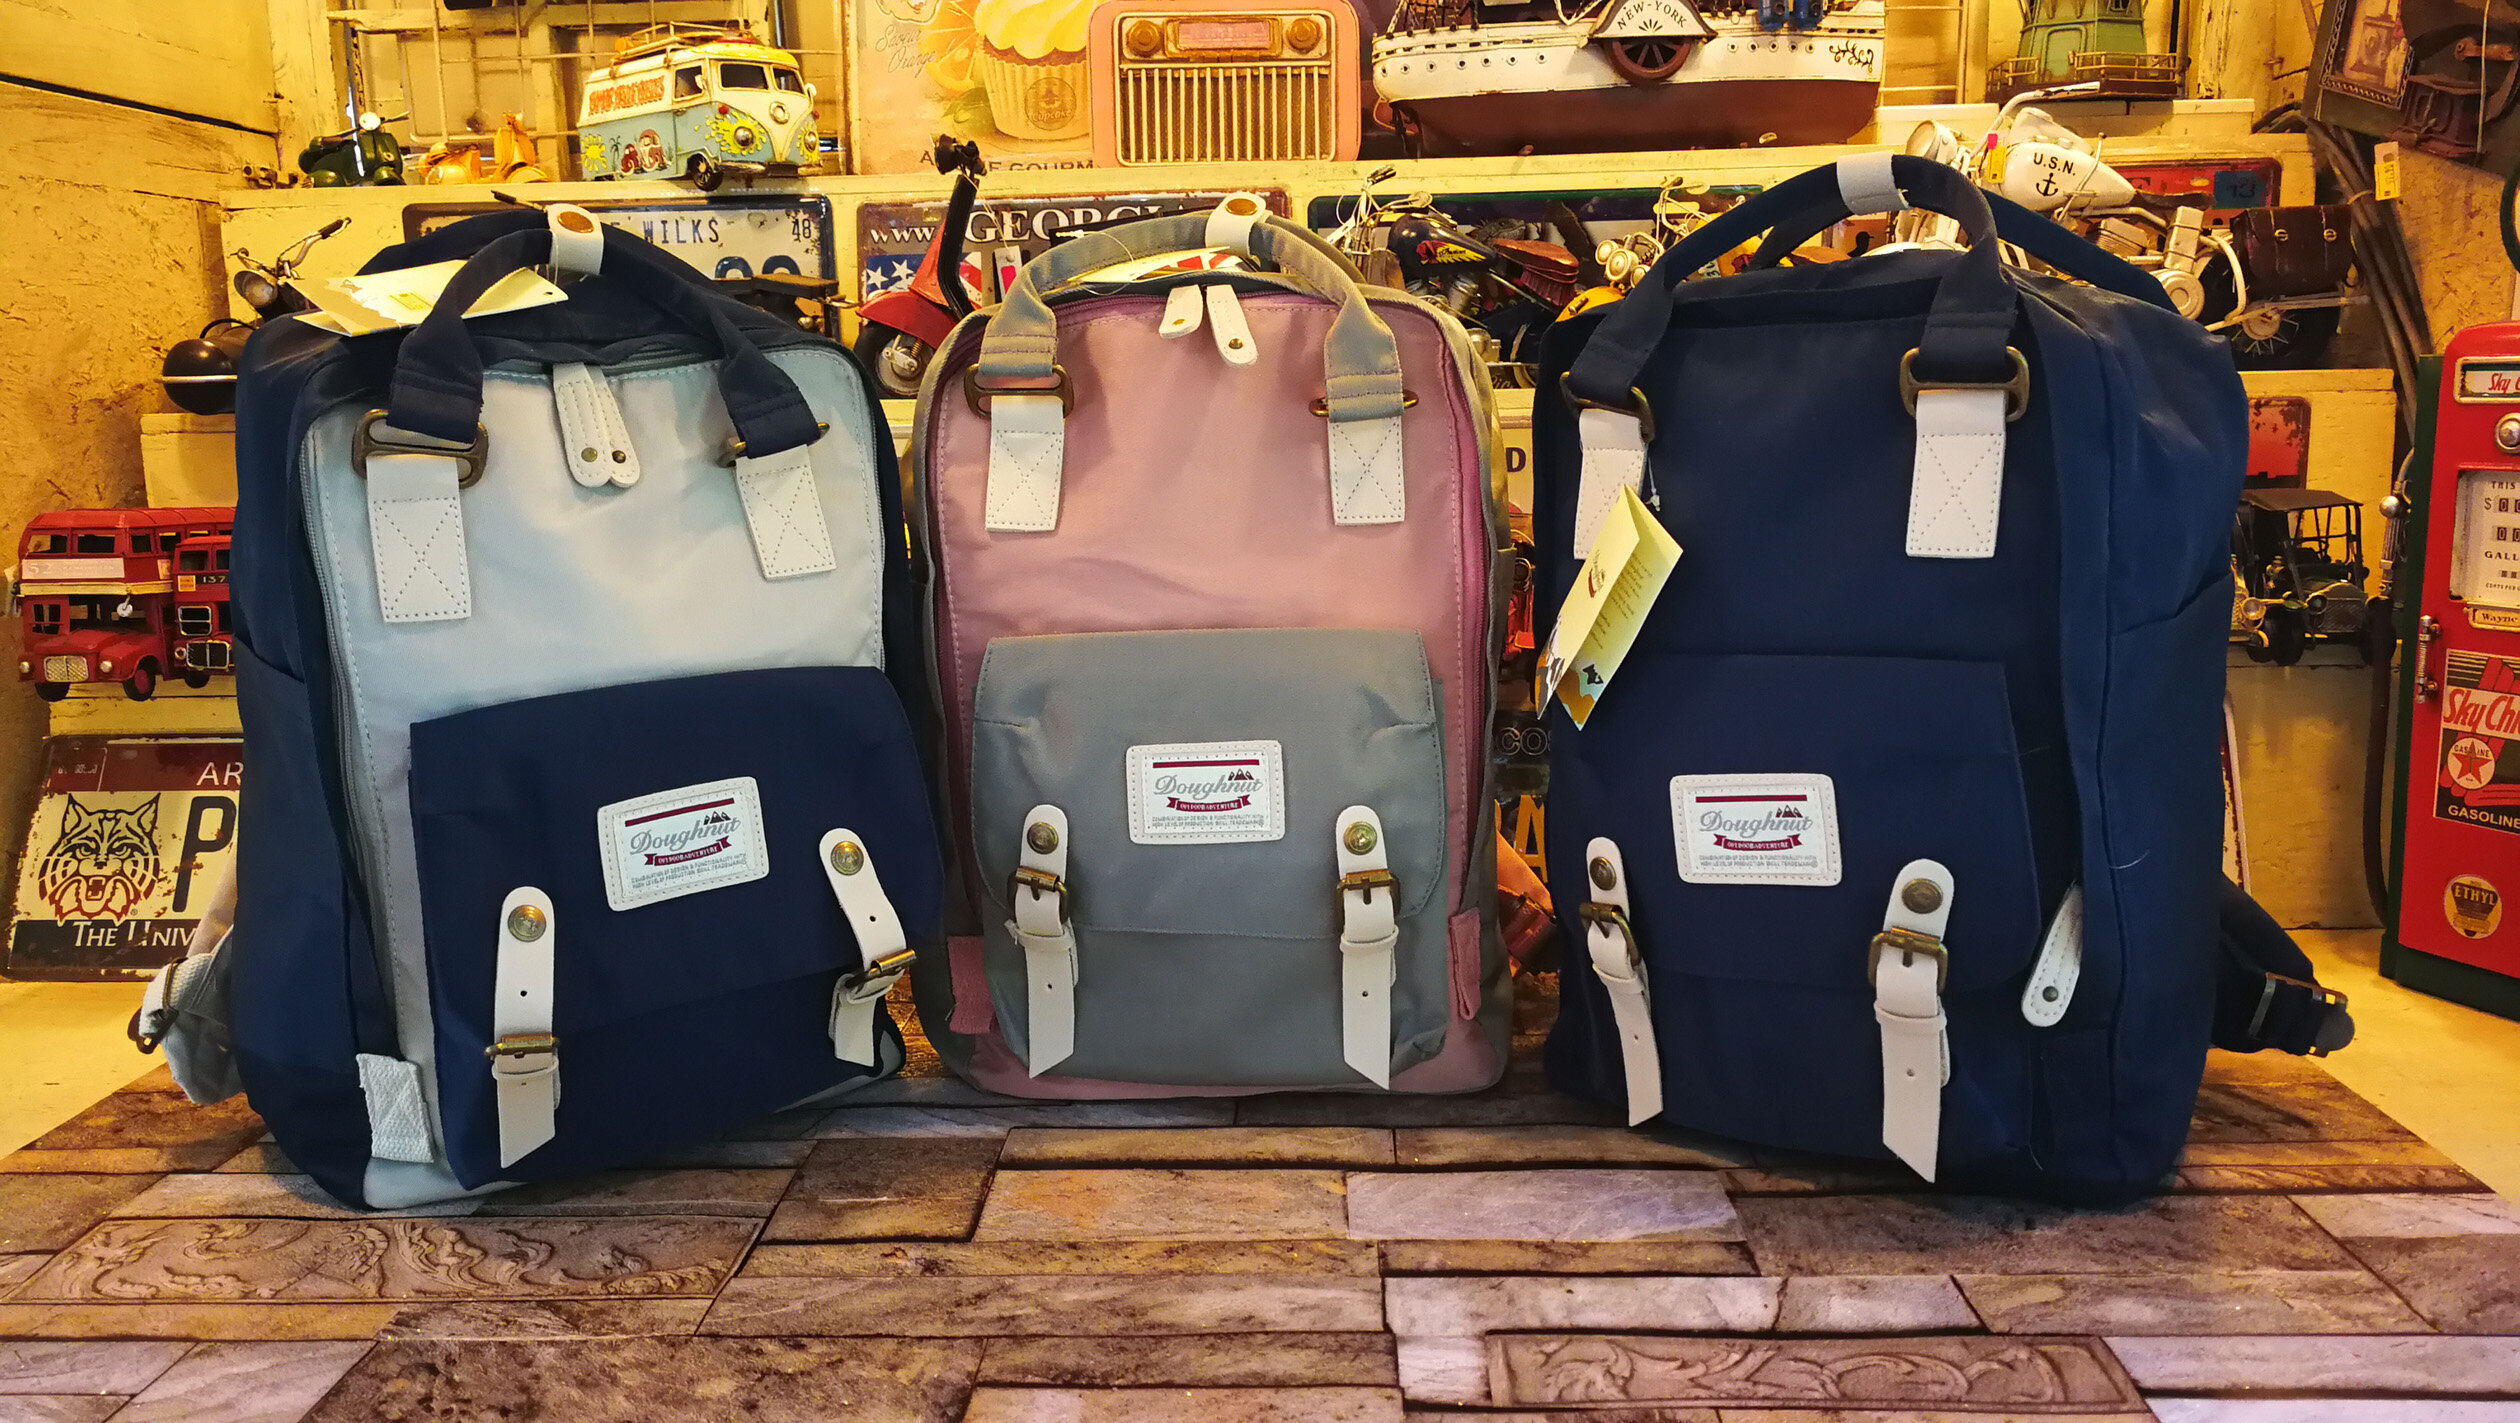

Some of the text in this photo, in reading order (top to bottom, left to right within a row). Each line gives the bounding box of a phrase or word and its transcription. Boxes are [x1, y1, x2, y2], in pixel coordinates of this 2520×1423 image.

[2033, 152, 2076, 176] U.S.N.
[643, 219, 720, 244] WILKS
[2488, 373, 2511, 393] Sky
[2491, 481, 2516, 490] THIS
[203, 576, 226, 584] 137
[2443, 688, 2486, 733] Sky
[1154, 775, 1264, 800] Doughnut
[1699, 810, 1813, 838] Doughnut
[2448, 804, 2520, 830] GASOLINE
[630, 819, 741, 855] Doughnut
[172, 796, 237, 913] P
[2455, 885, 2494, 906] ETHYL
